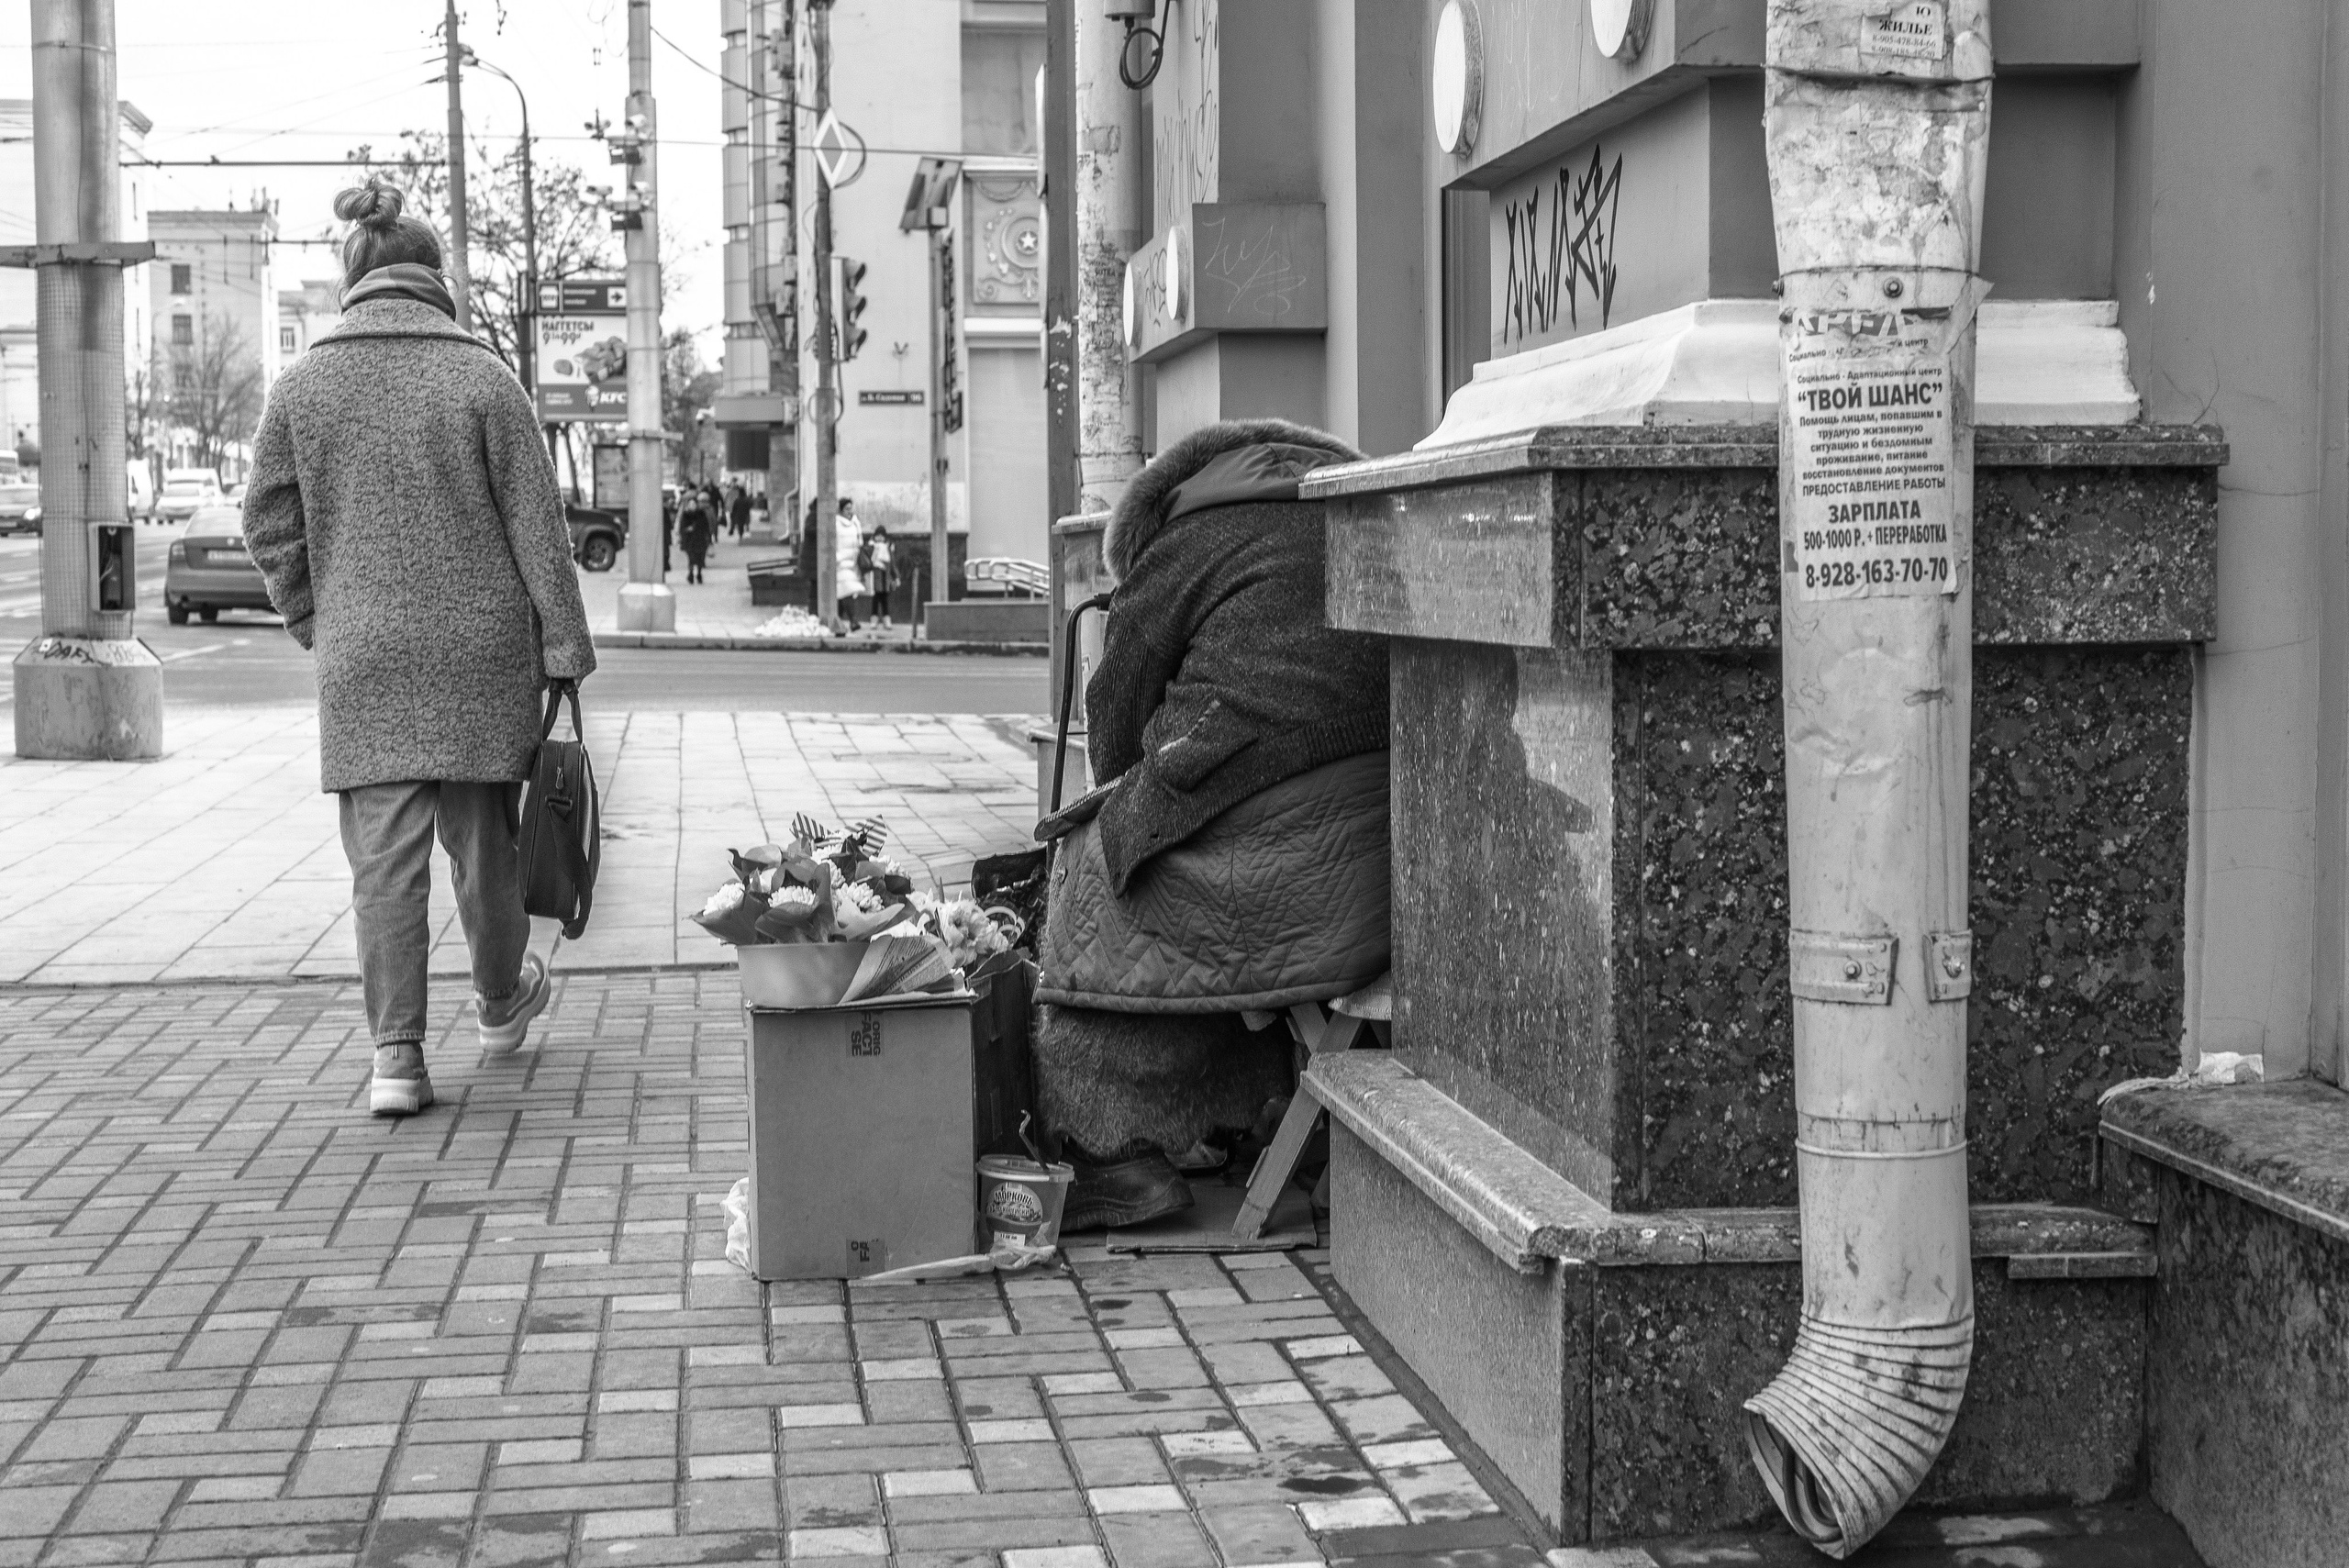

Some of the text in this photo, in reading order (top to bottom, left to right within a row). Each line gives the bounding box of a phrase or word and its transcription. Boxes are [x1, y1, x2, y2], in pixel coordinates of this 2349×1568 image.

[1878, 19, 1933, 35] ЖИЛЬЕ
[1797, 373, 1841, 384] Социально
[1847, 368, 1916, 381] Адаптационный
[1918, 368, 1943, 377] центр
[1799, 410, 1943, 428] Помощь лицам, попавшим в
[1818, 425, 1924, 439] трудную жизненную
[1810, 436, 1933, 453] ситуацию и бездомным
[1816, 450, 1929, 466] проживание, питание
[1802, 463, 1945, 480] восстановление документов
[1802, 477, 1946, 497] ПРЕДОСТАВЛЕНИЕ РАБОТЫ
[1828, 500, 1921, 524] ЗАРПЛАТА
[1804, 529, 1853, 550] 500-1000
[1876, 523, 1947, 546] ПЕРЕРАБОТКА
[1805, 556, 1948, 588] 8-928-163-70-70
